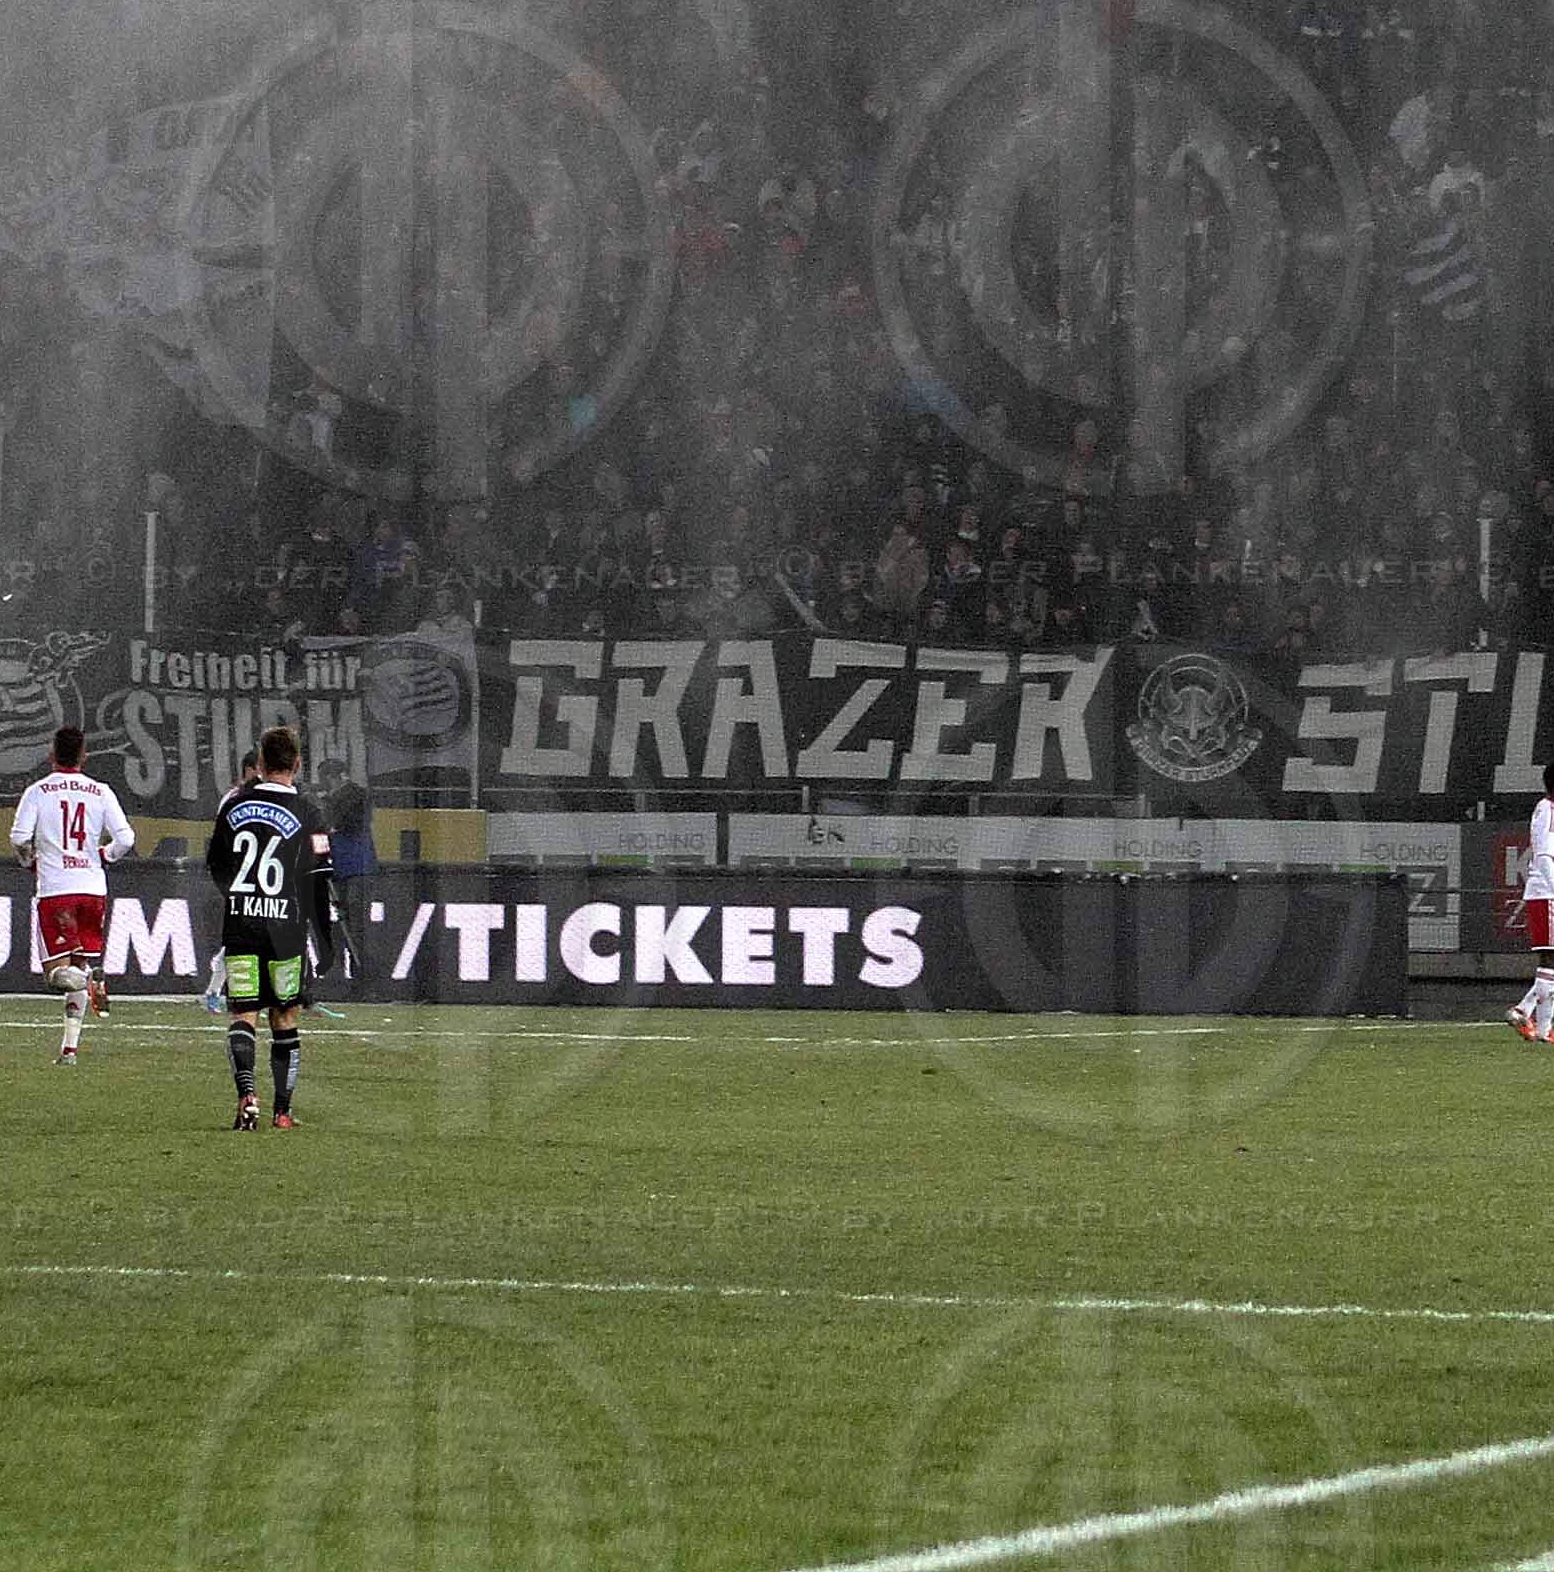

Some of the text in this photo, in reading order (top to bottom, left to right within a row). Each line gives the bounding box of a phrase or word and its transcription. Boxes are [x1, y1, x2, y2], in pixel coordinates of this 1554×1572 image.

[130, 638, 362, 690] Freiheit für
[501, 637, 1116, 782] GRAZER
[39, 780, 68, 794] Red
[70, 781, 102, 797] Bulls
[60, 799, 87, 851] 14
[230, 805, 295, 833] PUNTIGAMER
[618, 832, 706, 852] HOLDING
[870, 834, 959, 856] HOLDING
[1114, 840, 1203, 859] HOLDING
[1359, 842, 1450, 862] HOLDING
[229, 830, 285, 896] 26
[244, 896, 289, 920] KAINZ
